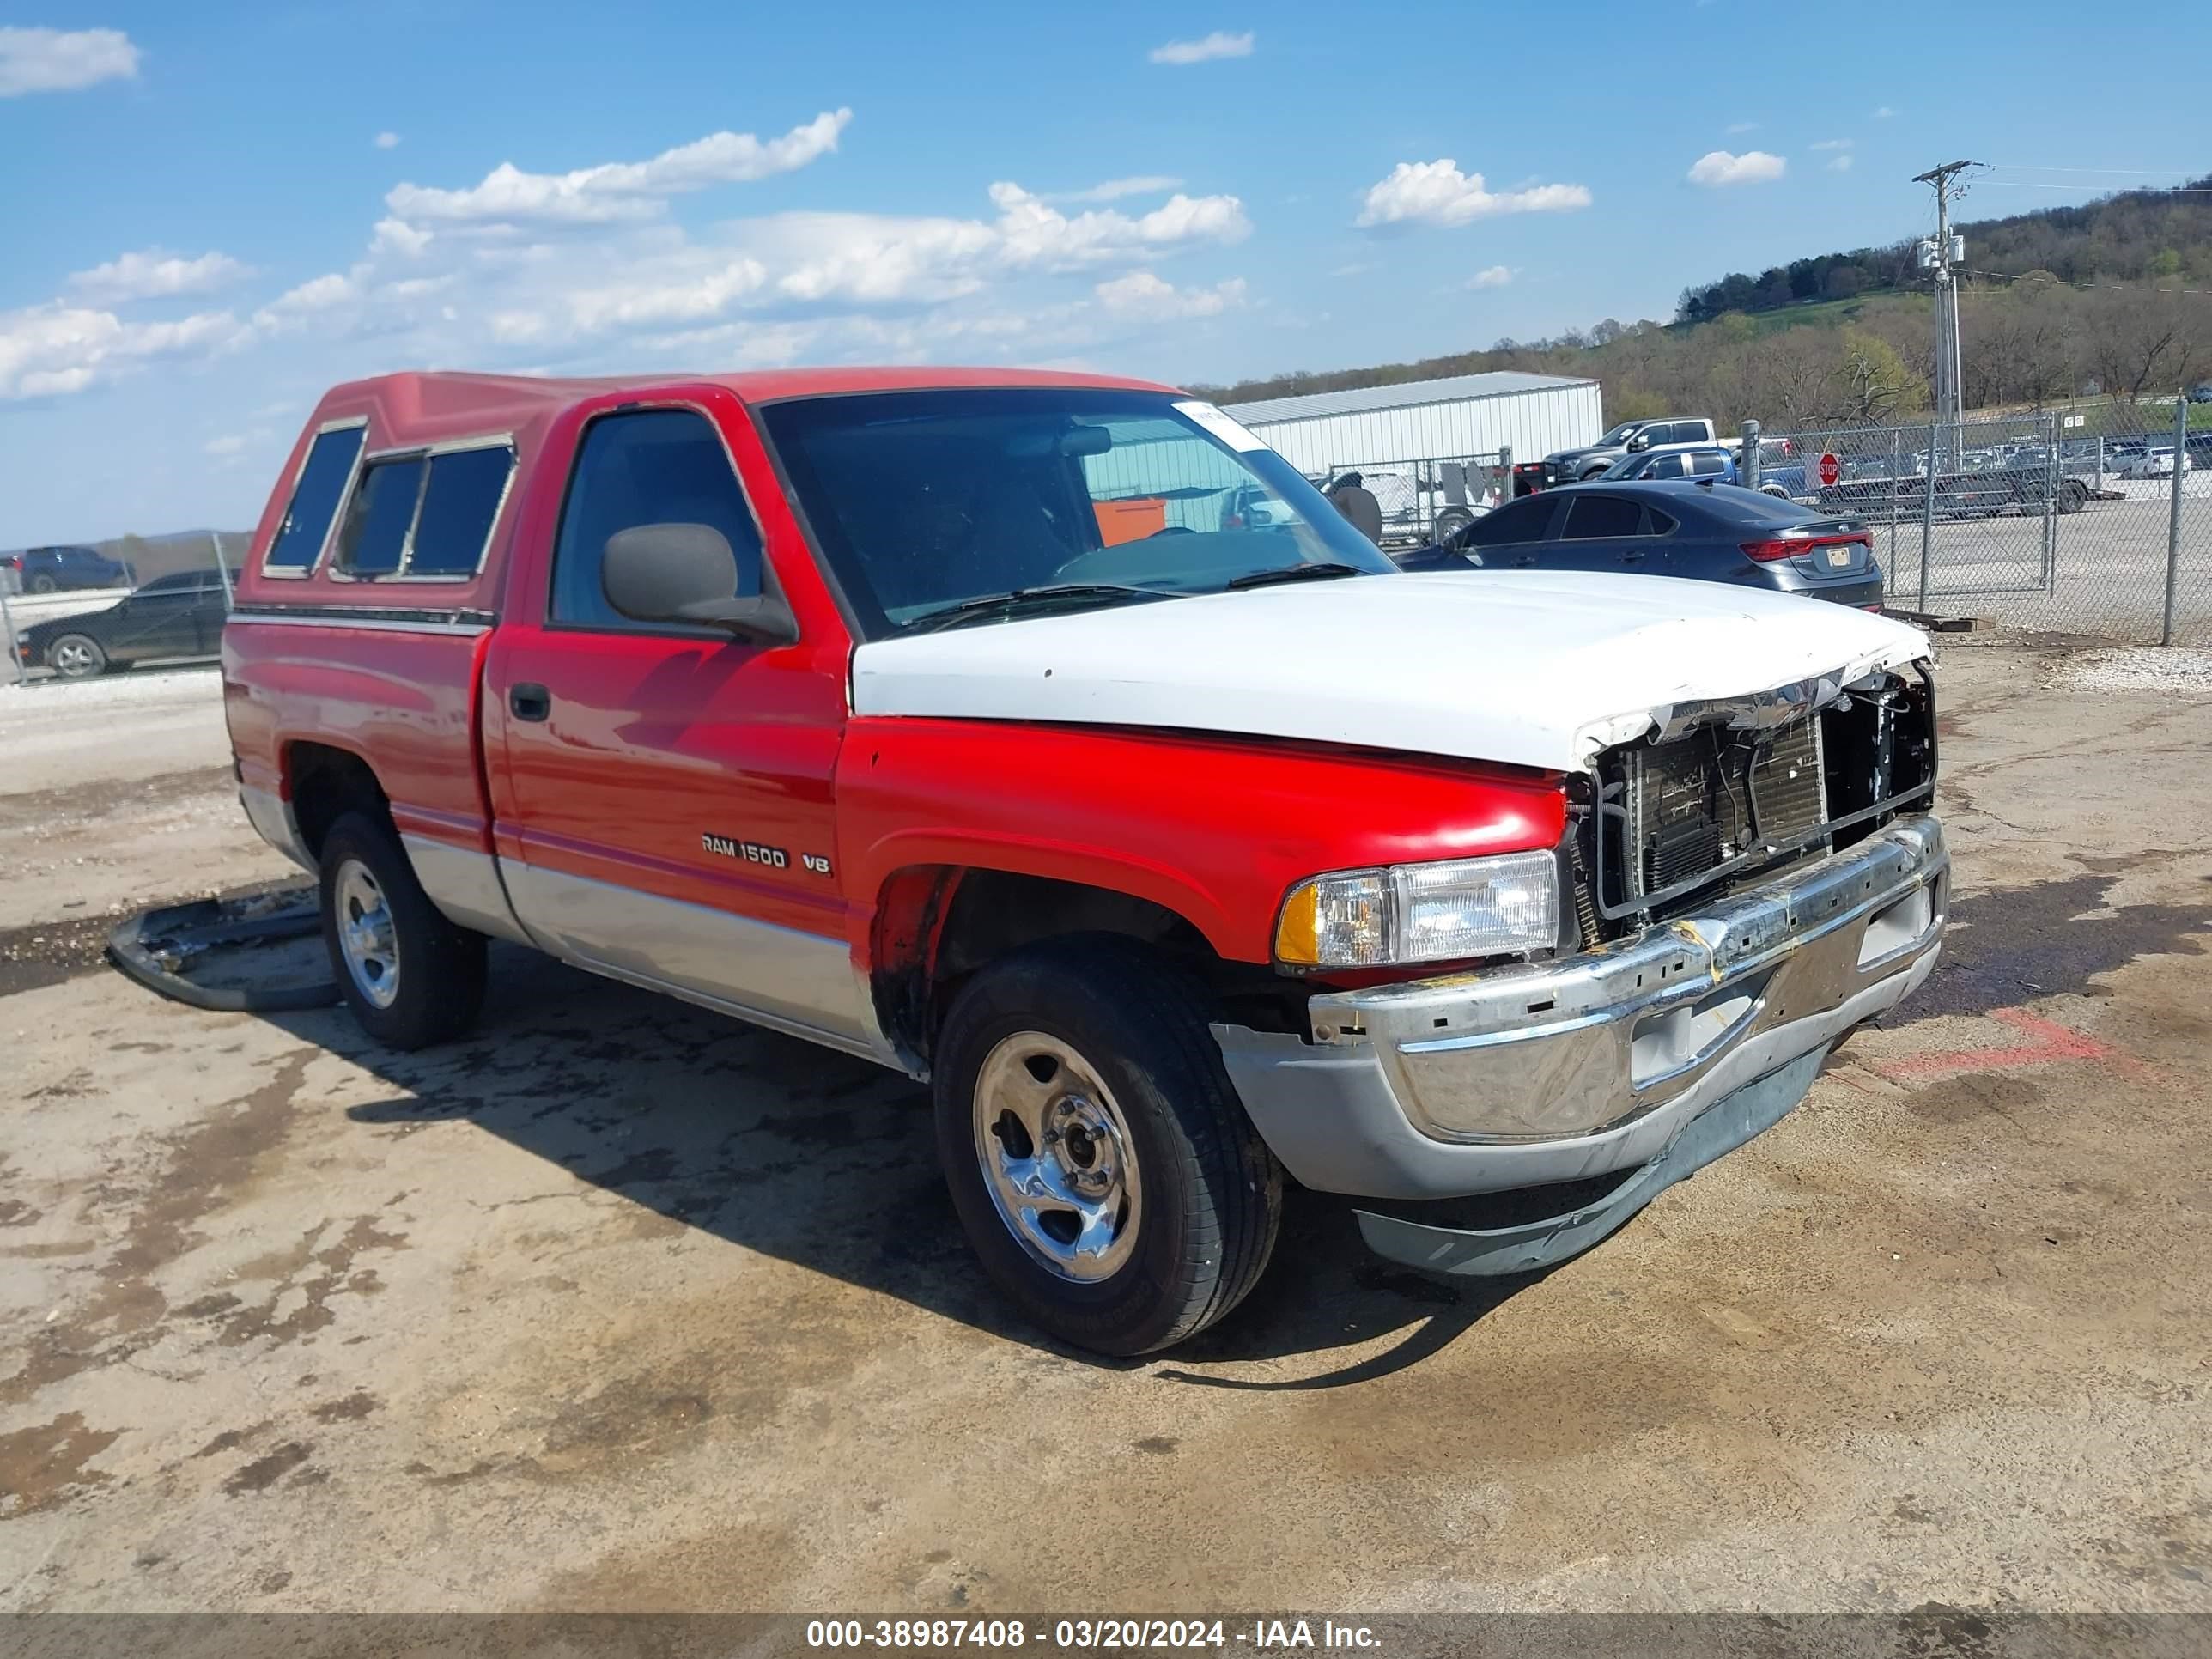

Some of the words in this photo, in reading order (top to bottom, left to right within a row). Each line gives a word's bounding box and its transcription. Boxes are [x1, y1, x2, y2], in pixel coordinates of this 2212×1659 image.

[1820, 463, 1837, 476] STOP
[701, 835, 736, 858] RAM
[740, 843, 787, 868] 1500
[802, 854, 830, 873] V8
